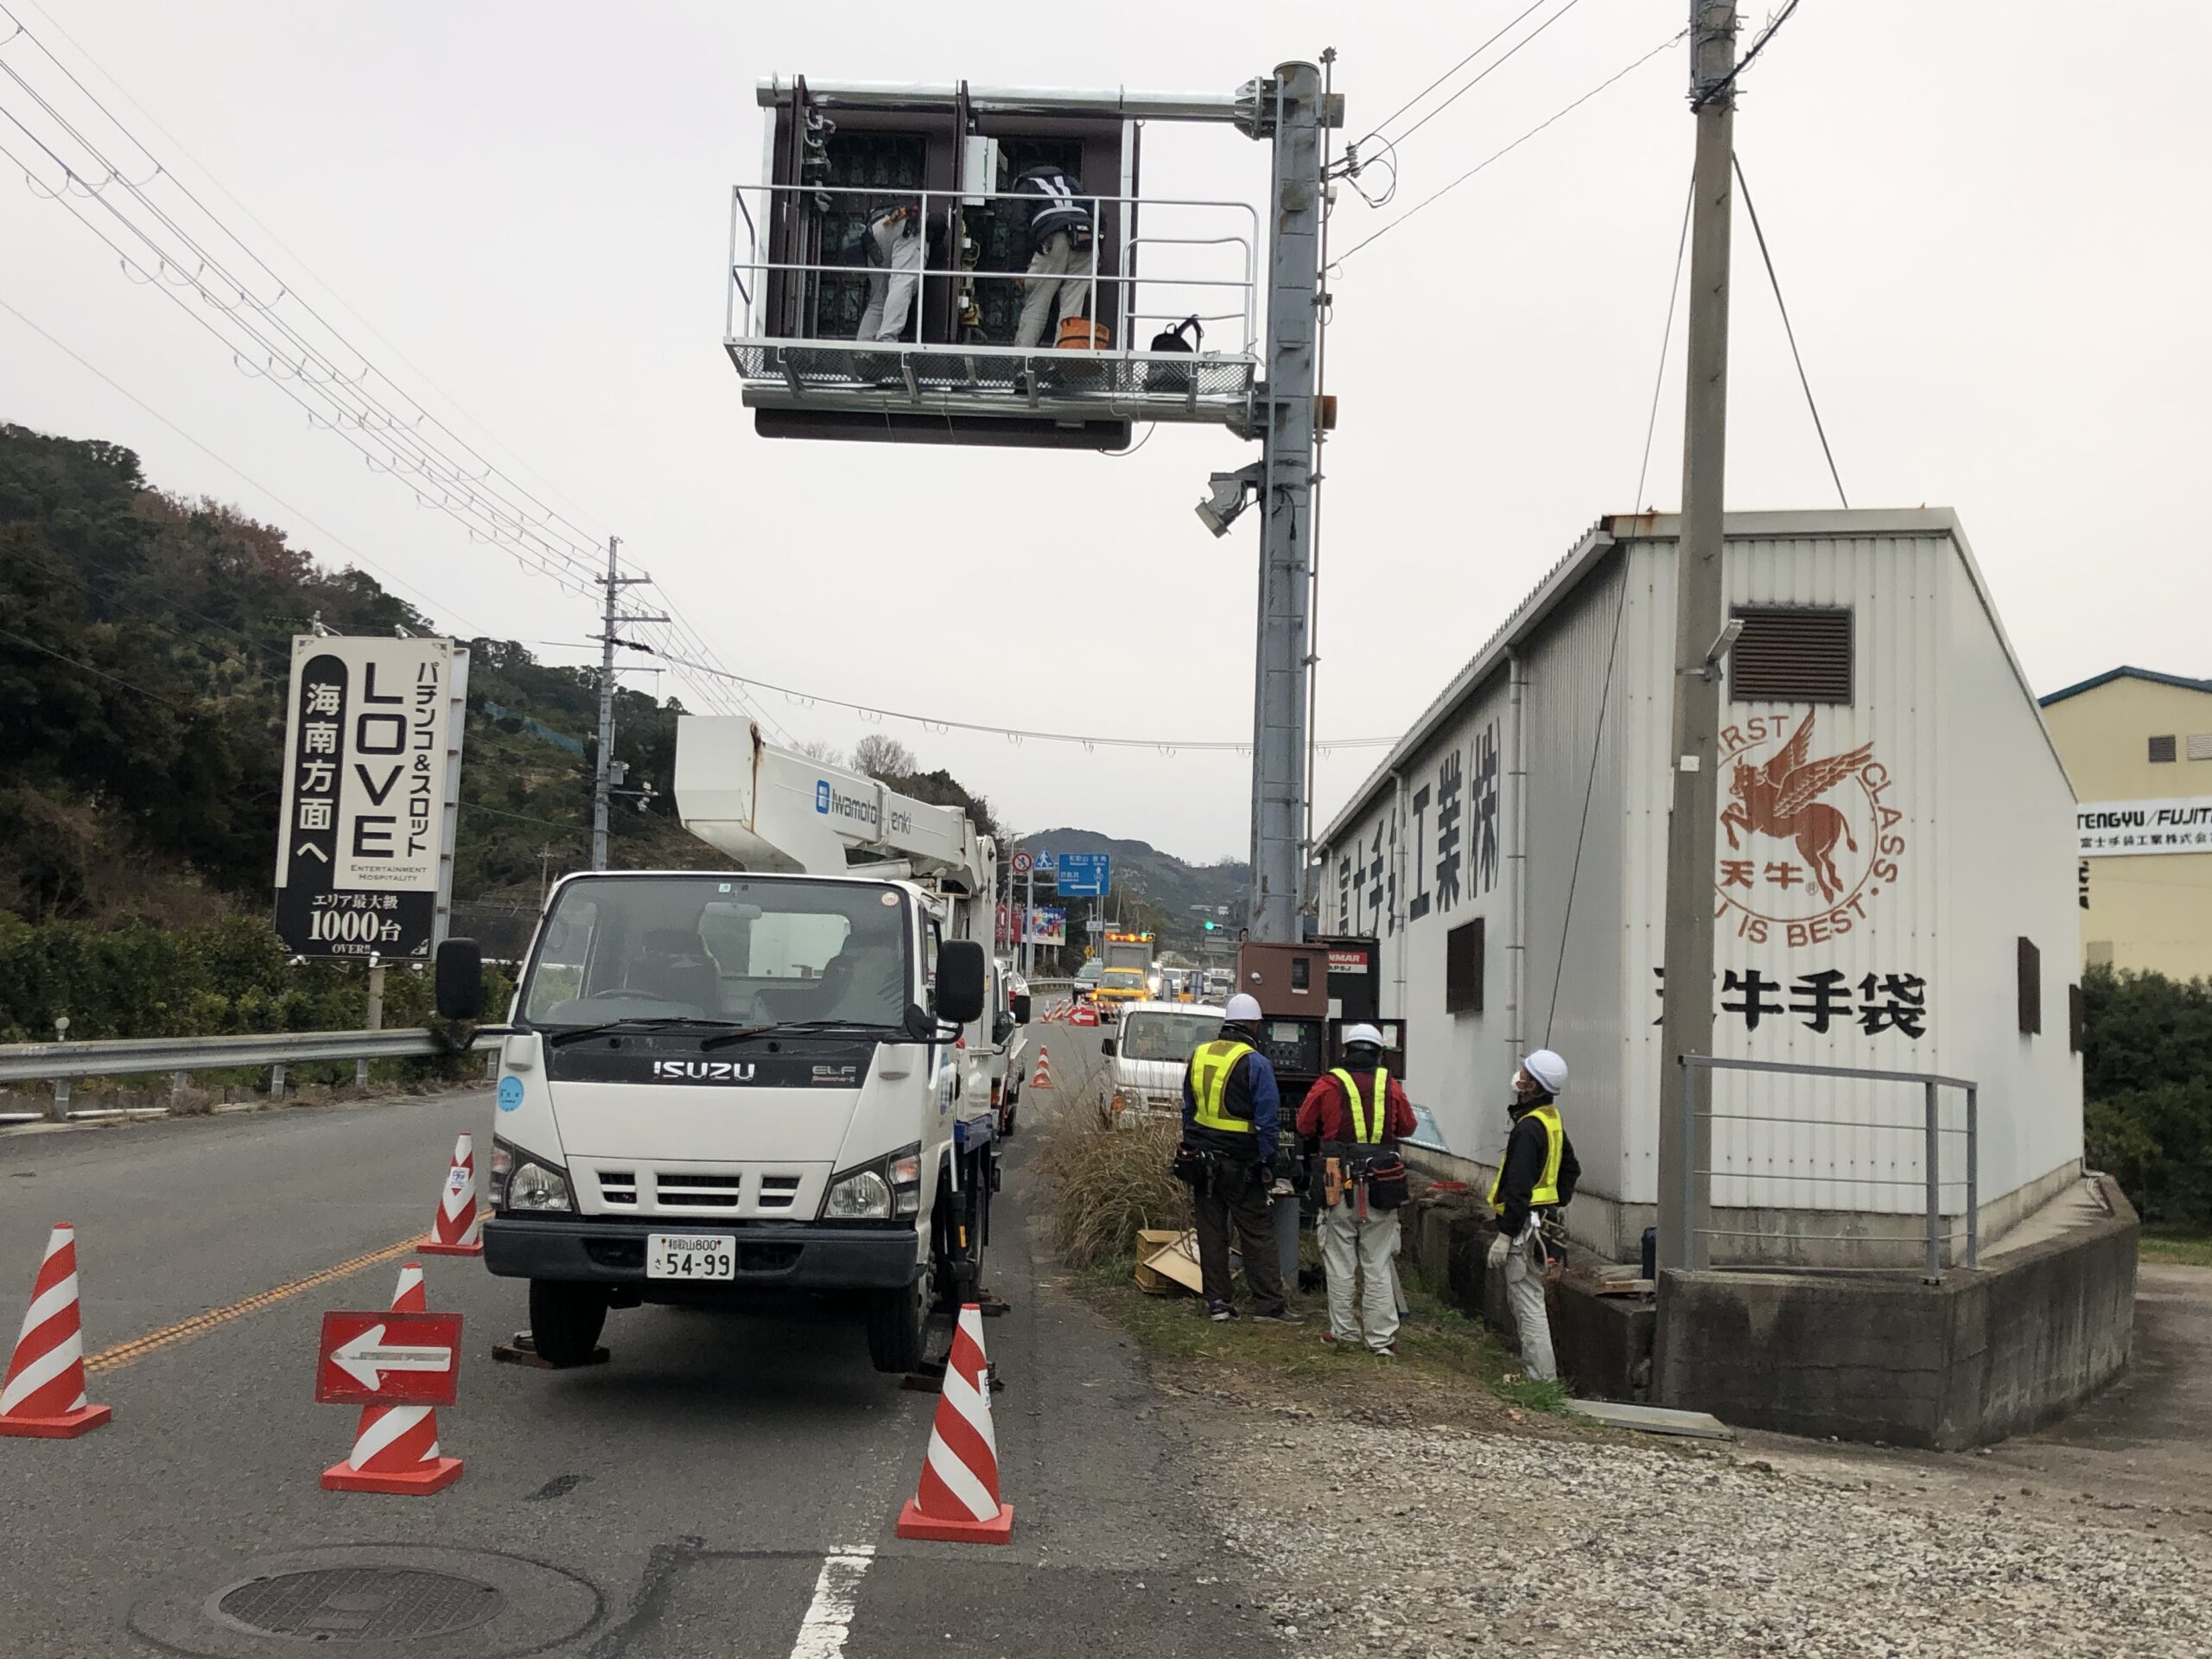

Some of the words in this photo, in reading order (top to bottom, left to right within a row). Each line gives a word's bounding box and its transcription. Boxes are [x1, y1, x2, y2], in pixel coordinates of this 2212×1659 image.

[296, 682, 341, 864] 海南方面へ
[352, 661, 408, 859] LOVE
[407, 661, 439, 859] パチンコ&スロット
[832, 788, 877, 825] Iwamoto
[890, 810, 912, 835] enki
[1716, 715, 1789, 757] RST
[1861, 763, 1905, 884] CLASS
[2080, 831, 2212, 849] 富士手袋工業株式会
[312, 893, 398, 910] エリア最大級
[308, 910, 402, 942] 1000台
[1738, 914, 1769, 944] IS
[1786, 892, 1866, 948] BEST
[1327, 954, 1360, 963] NMAR
[653, 1060, 755, 1081] ISUZU
[812, 1065, 856, 1075] ELF
[666, 1253, 730, 1276] 54-99
